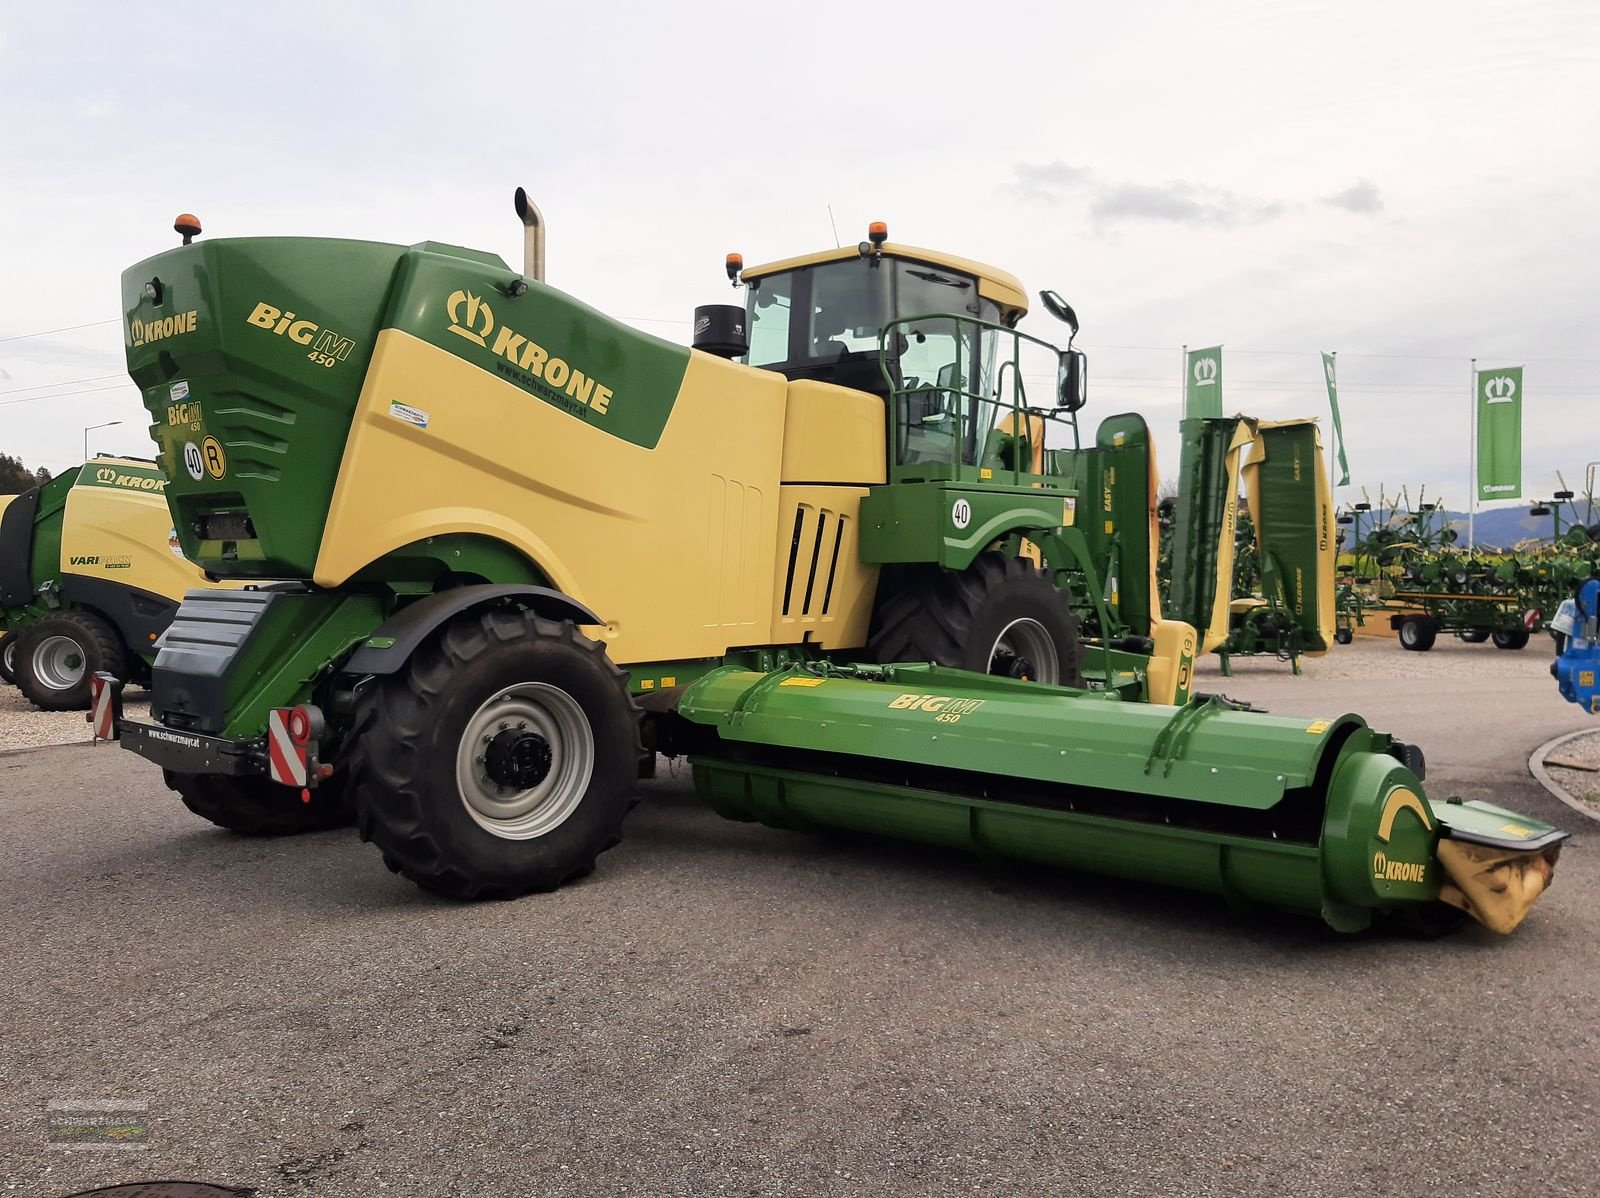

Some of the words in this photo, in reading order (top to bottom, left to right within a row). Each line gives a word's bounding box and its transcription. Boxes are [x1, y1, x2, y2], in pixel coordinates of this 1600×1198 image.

[144, 309, 198, 344] KRONE
[246, 301, 319, 346] BiG
[307, 351, 336, 368] 450
[491, 325, 614, 415] KRONE
[496, 361, 588, 418] www.schwarzmayr.at
[167, 403, 189, 427] BiG
[190, 422, 201, 432] 450
[186, 448, 201, 474] 40
[206, 445, 222, 471] R
[115, 474, 165, 491] KRON
[954, 503, 968, 524] 40
[888, 694, 952, 713] BiG
[934, 713, 961, 724] 450
[1385, 860, 1426, 883] KRONE
